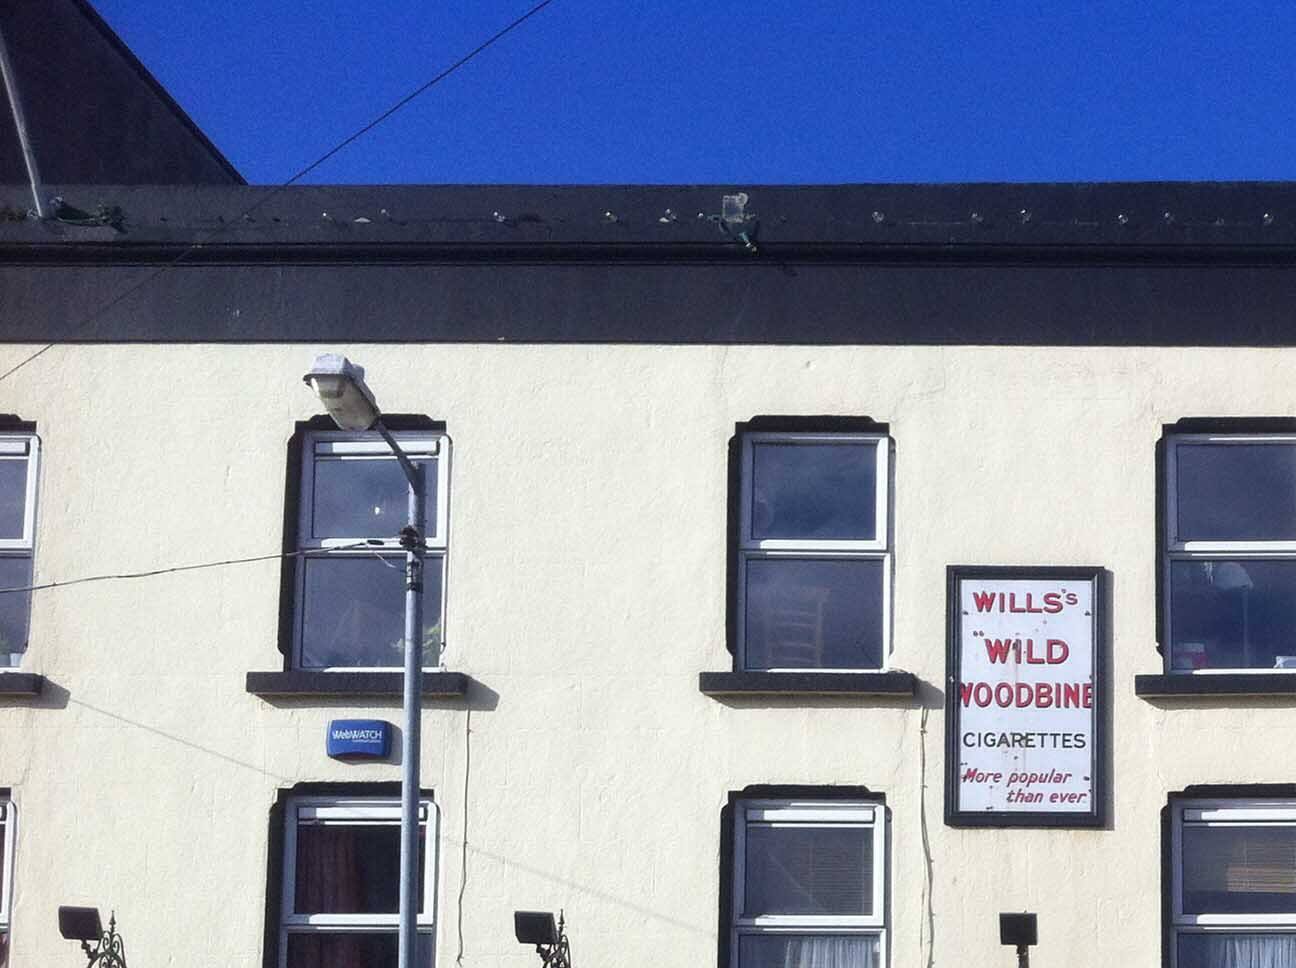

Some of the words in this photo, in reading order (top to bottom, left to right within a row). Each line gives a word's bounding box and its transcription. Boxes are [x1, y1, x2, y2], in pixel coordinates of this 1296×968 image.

[963, 732, 1086, 749] CIGARETTES
[963, 768, 1002, 783] More
[1006, 768, 1072, 787] popular
[1006, 788, 1044, 803] than
[1049, 792, 1088, 804] ever
